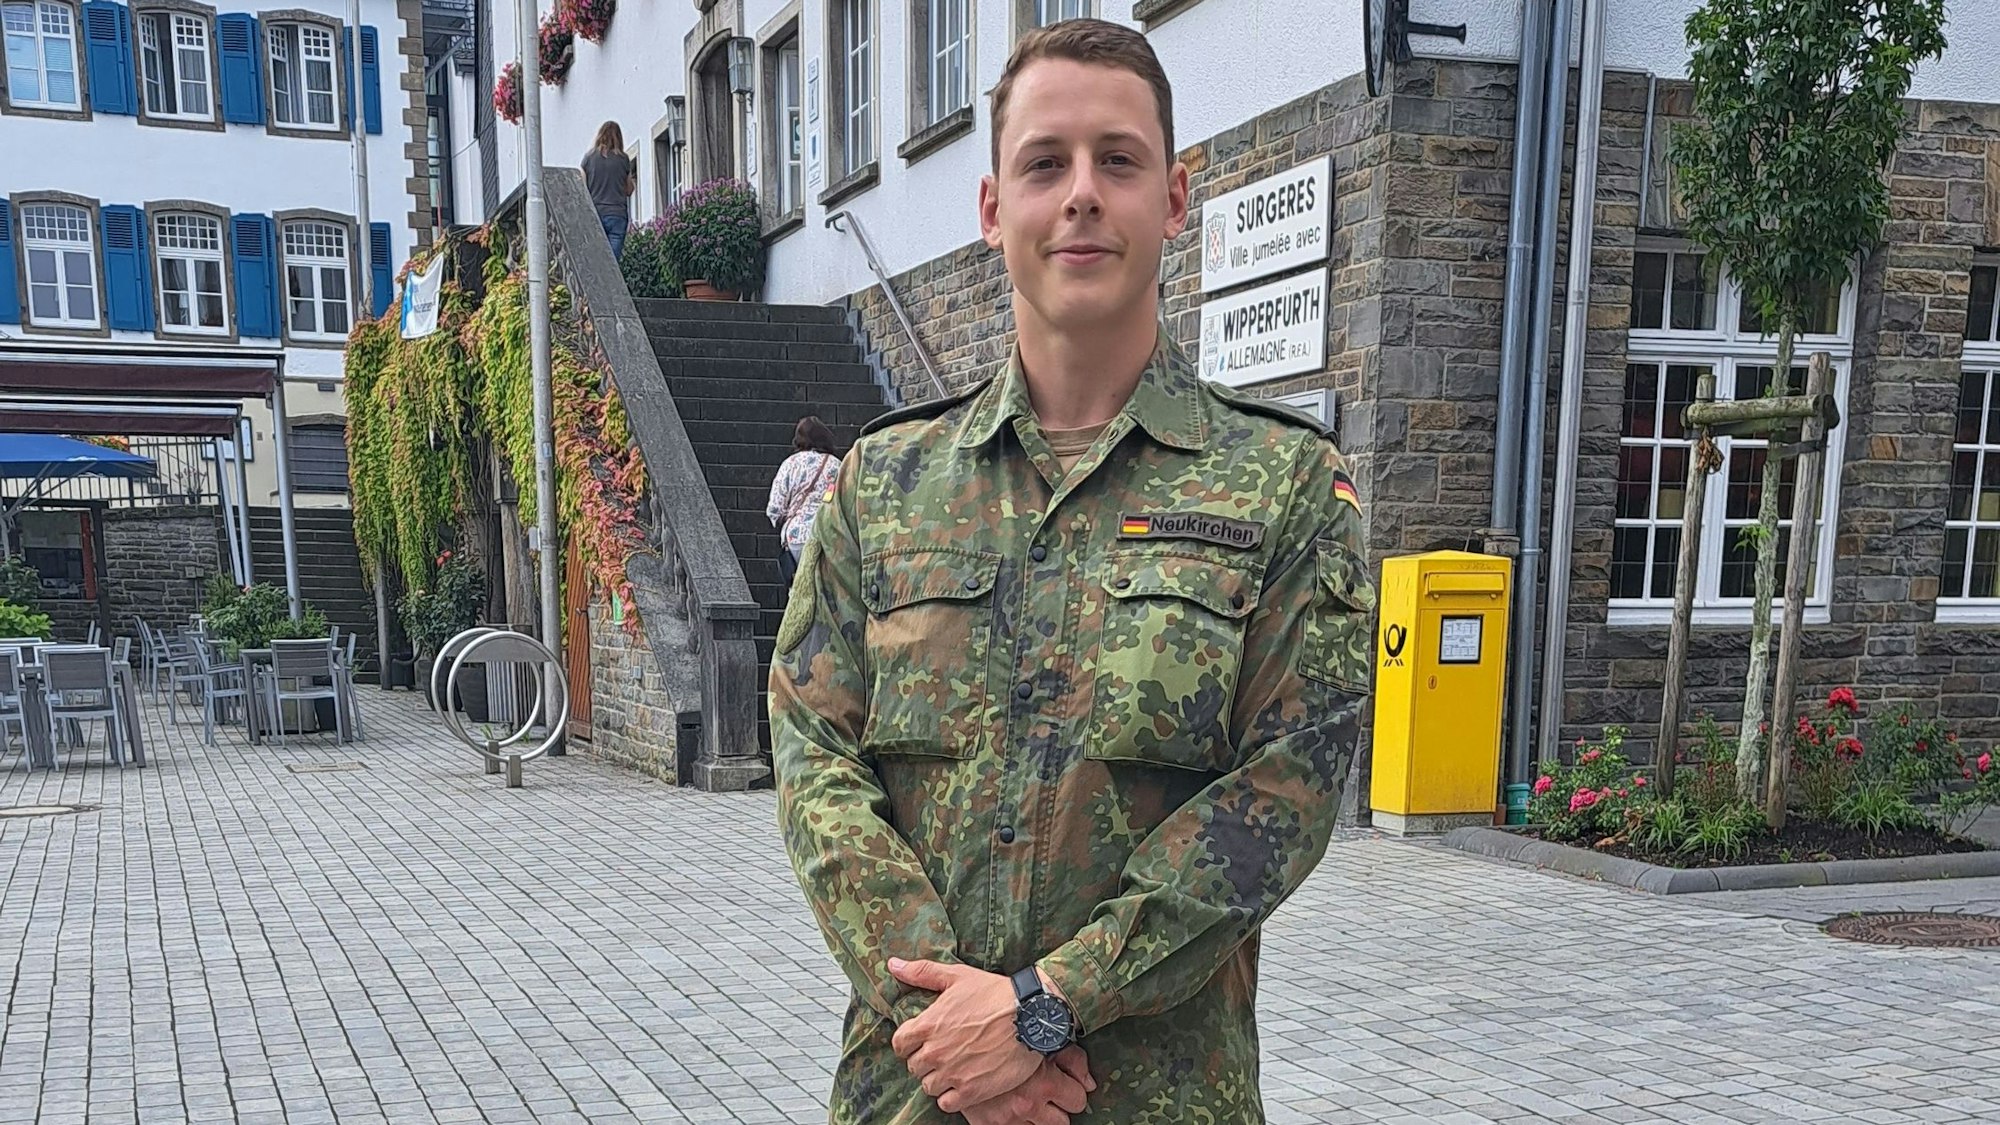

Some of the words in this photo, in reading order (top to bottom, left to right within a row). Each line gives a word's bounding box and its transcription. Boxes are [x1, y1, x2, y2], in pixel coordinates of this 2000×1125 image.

[1237, 176, 1315, 233] SURGERES
[1230, 246, 1249, 269] Ville
[1252, 233, 1291, 266] jumelée
[1296, 225, 1321, 249] avec
[1223, 286, 1320, 343] WIPPERFÜRTH
[1227, 338, 1287, 372] ALLEMAGNE
[1151, 516, 1253, 542] Neukirchen
